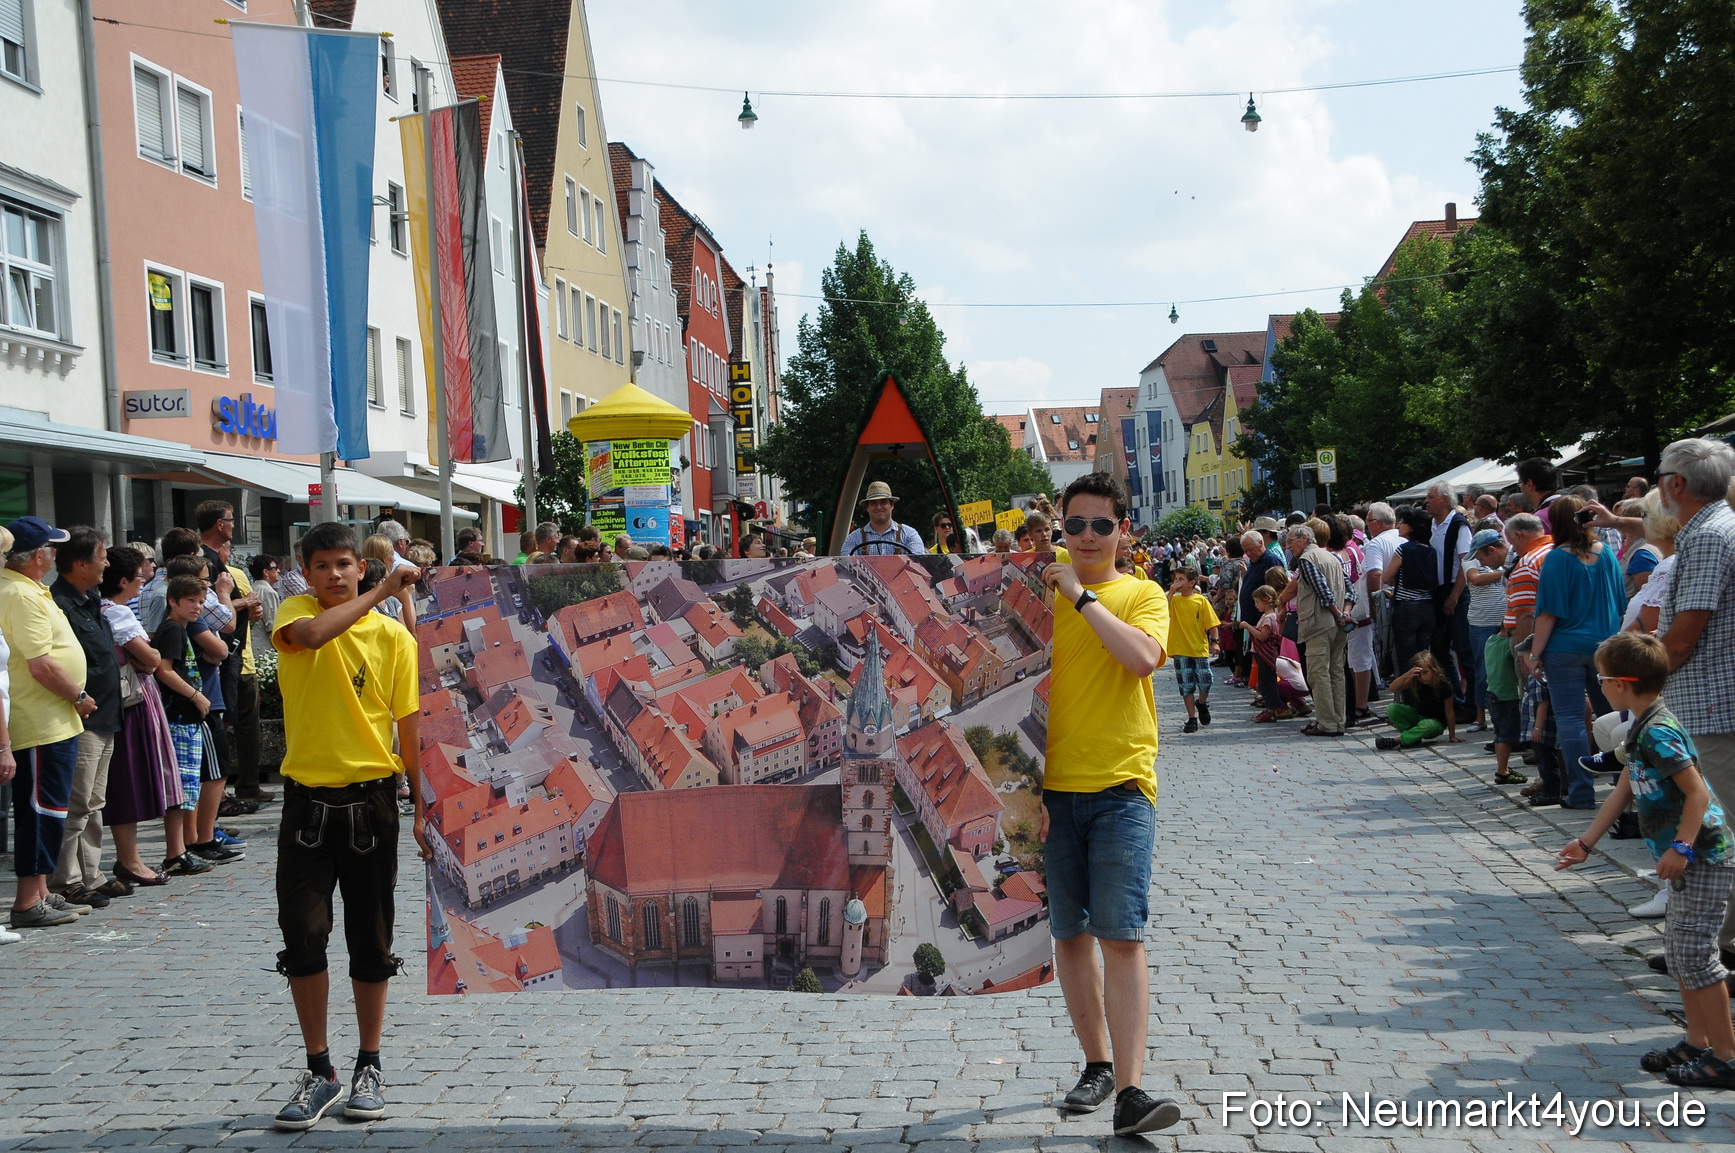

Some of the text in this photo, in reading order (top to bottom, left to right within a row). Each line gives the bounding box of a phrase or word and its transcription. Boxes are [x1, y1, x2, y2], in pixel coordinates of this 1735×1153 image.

[731, 364, 754, 471] HOTEL
[613, 442, 630, 450] New
[613, 450, 669, 460] Volksfest
